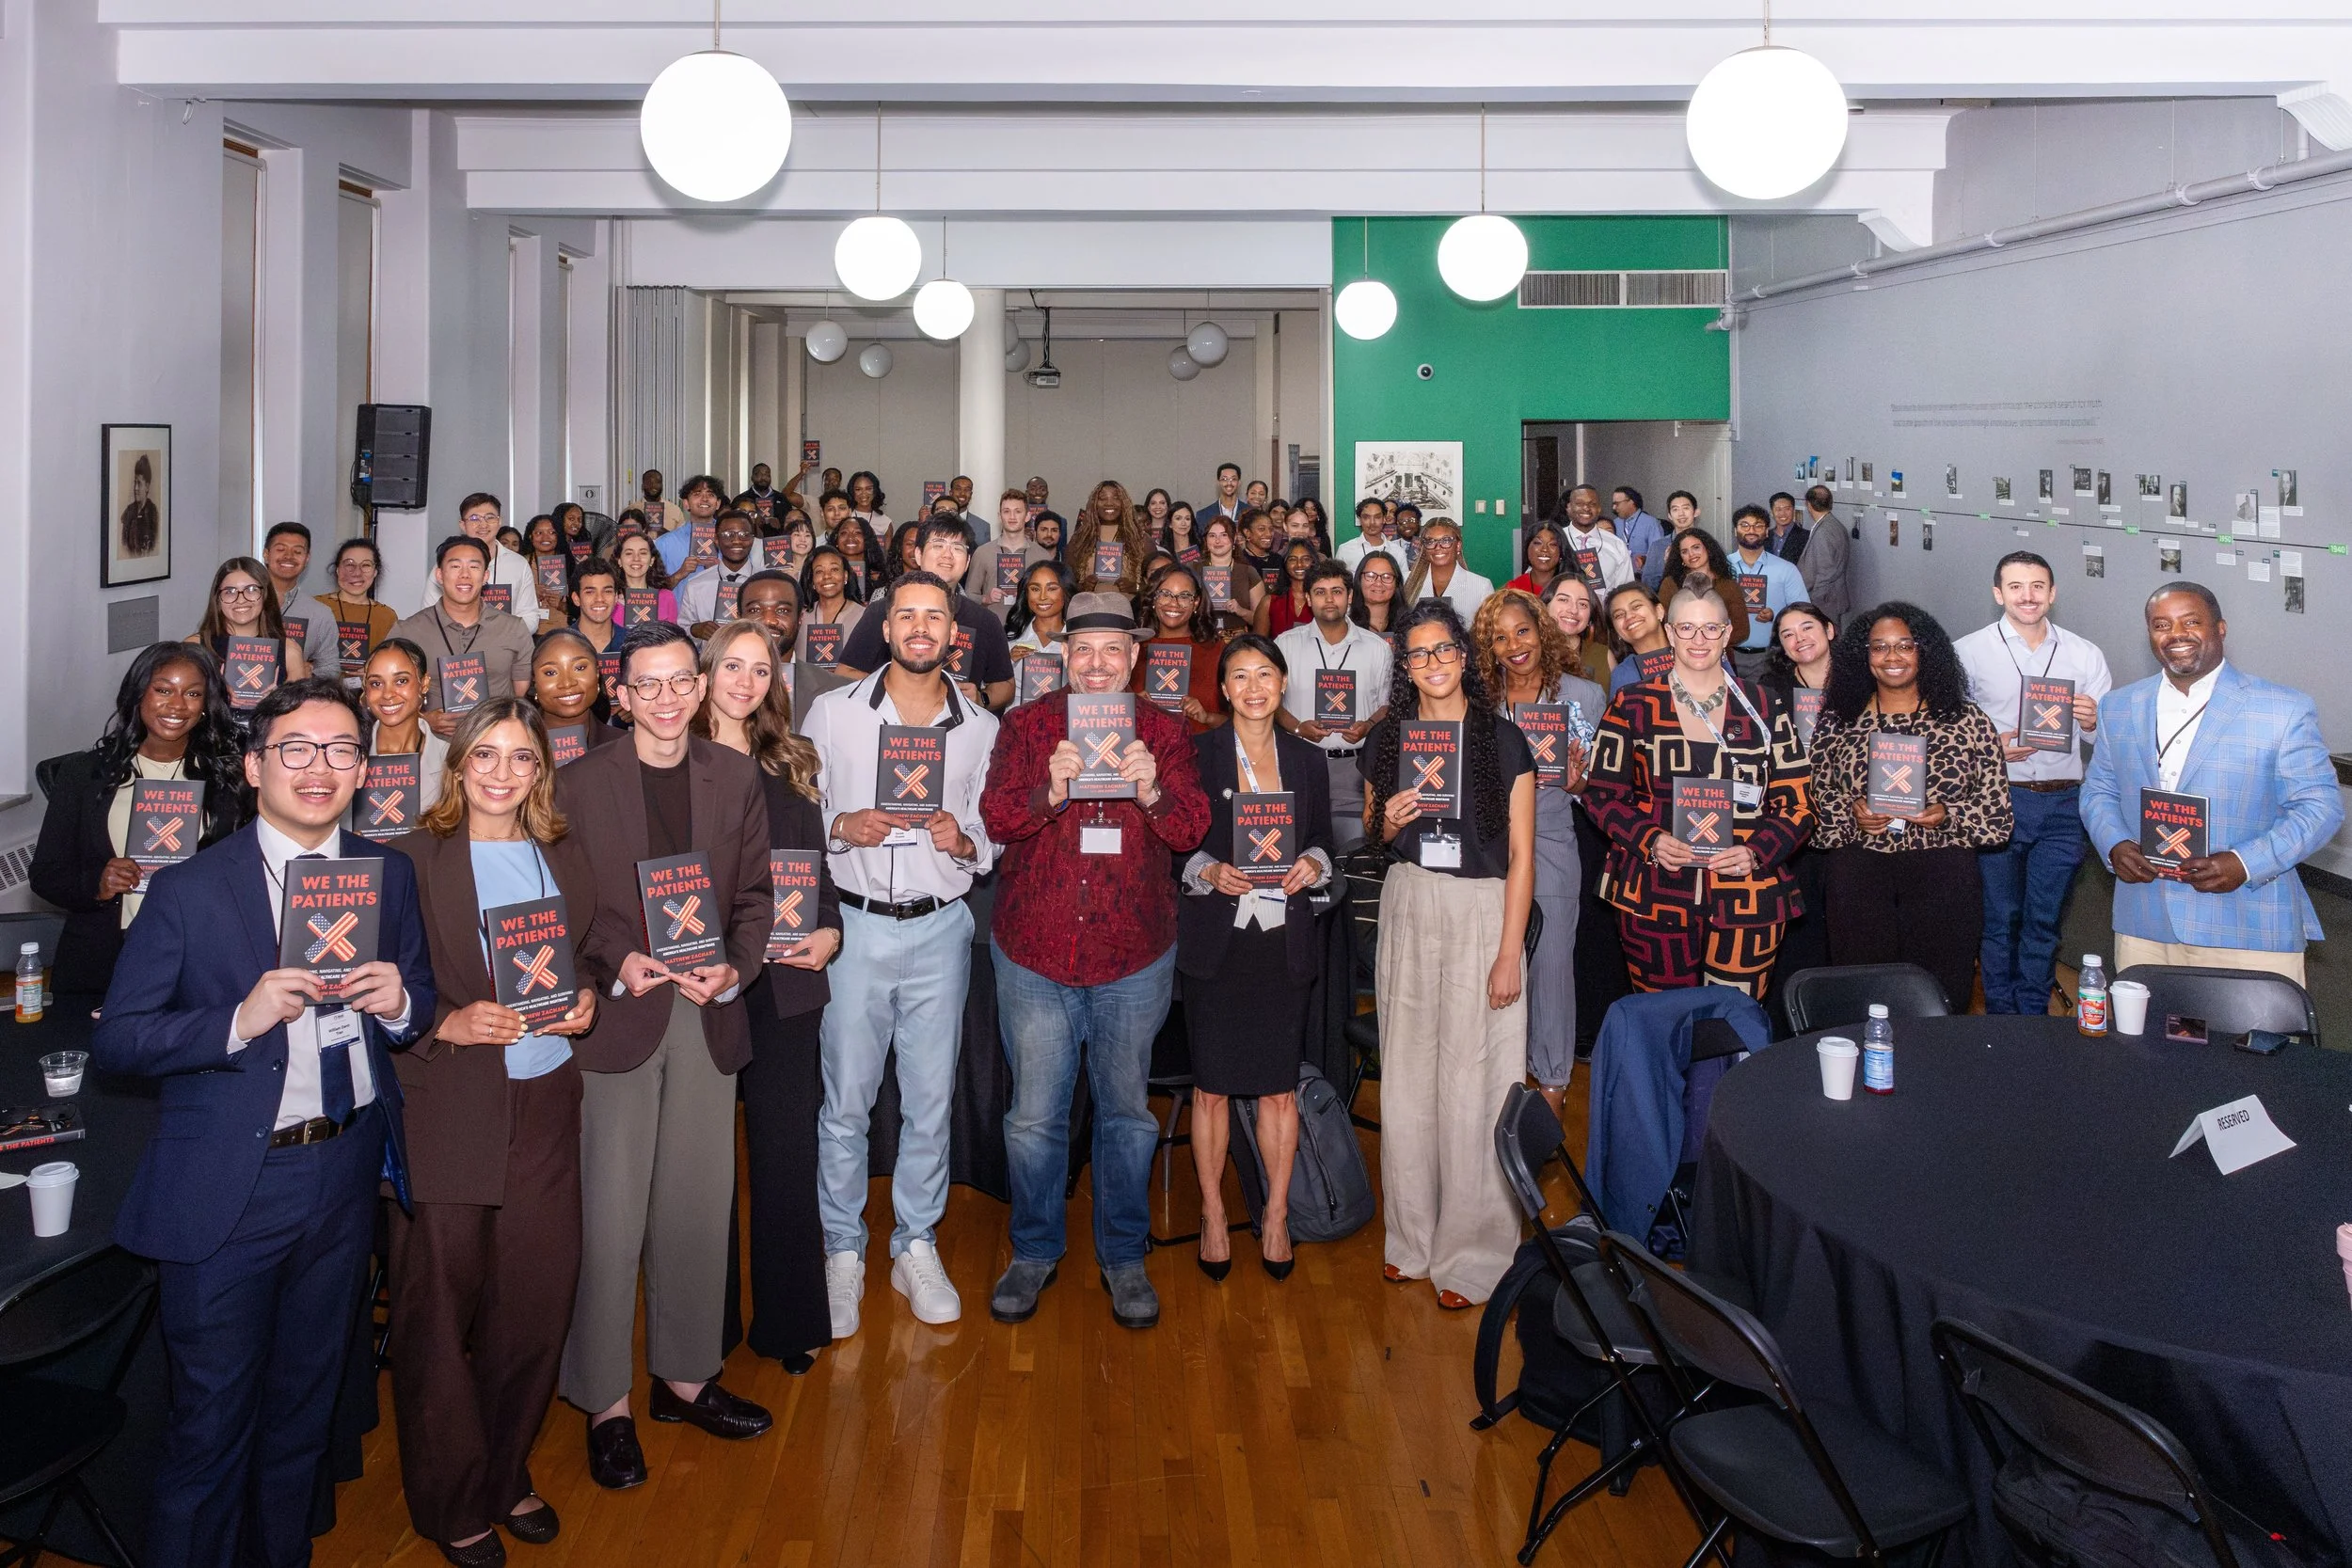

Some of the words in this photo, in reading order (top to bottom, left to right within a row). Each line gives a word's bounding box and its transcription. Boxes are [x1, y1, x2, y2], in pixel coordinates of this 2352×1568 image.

[957, 631, 971, 641] THE
[954, 639, 972, 649] ENTS
[229, 652, 275, 662] PATIENTS
[1644, 658, 1658, 666] WE
[462, 659, 479, 669] THE
[1643, 663, 1675, 674] PATIEN
[443, 666, 484, 678] PATIENTS
[1026, 666, 1062, 674] PATIENTS
[2031, 684, 2045, 692] WE
[2049, 685, 2068, 694] THE
[2025, 692, 2072, 704] PATIENTS
[1078, 705, 1098, 715] WE
[1102, 705, 1125, 715] THE
[1073, 717, 1133, 728] PATIENTS
[1543, 713, 1561, 721] THE
[1519, 722, 1565, 731] PATIENTS
[1409, 730, 1426, 740] WE
[1431, 731, 1451, 741] THE
[556, 737, 577, 747] THE
[890, 738, 909, 747] WE
[914, 738, 936, 748] THE
[1403, 742, 1455, 752] PATIENTS
[554, 747, 585, 760] ENTS
[883, 750, 941, 760] PATIENTS
[1872, 752, 1924, 763] PATIENTS
[365, 766, 382, 775] WE
[388, 765, 409, 773] THE
[145, 791, 164, 800] WE
[170, 790, 192, 802] THE
[1683, 787, 1699, 797] WE
[1705, 789, 1724, 798] THE
[136, 803, 197, 813] PATIENTS
[1243, 805, 1261, 814] WE
[1266, 804, 1286, 813] THE
[1676, 798, 1731, 810] PATIENTS
[2151, 801, 2170, 811] WE
[2174, 803, 2196, 815] THE
[1238, 815, 1293, 825] PATIENTS
[2144, 810, 2203, 828] PATIENTS
[650, 869, 673, 882] WE
[677, 863, 702, 879] THE
[788, 862, 811, 873] THE
[302, 876, 330, 890] WE
[337, 874, 369, 888] THE
[773, 874, 816, 886] TIENTS
[647, 877, 711, 900] PATIENTS
[292, 891, 377, 909] PATIENTS
[502, 917, 526, 931] WE
[529, 910, 557, 926] THE
[496, 924, 566, 950] PATIENTS
[665, 955, 690, 964] MATTHEW
[691, 950, 716, 959] ZACHARY
[542, 1006, 568, 1015] ZACHARY
[2217, 1110, 2250, 1130] RESERVED
[21, 1137, 54, 1147] PATIENTS
